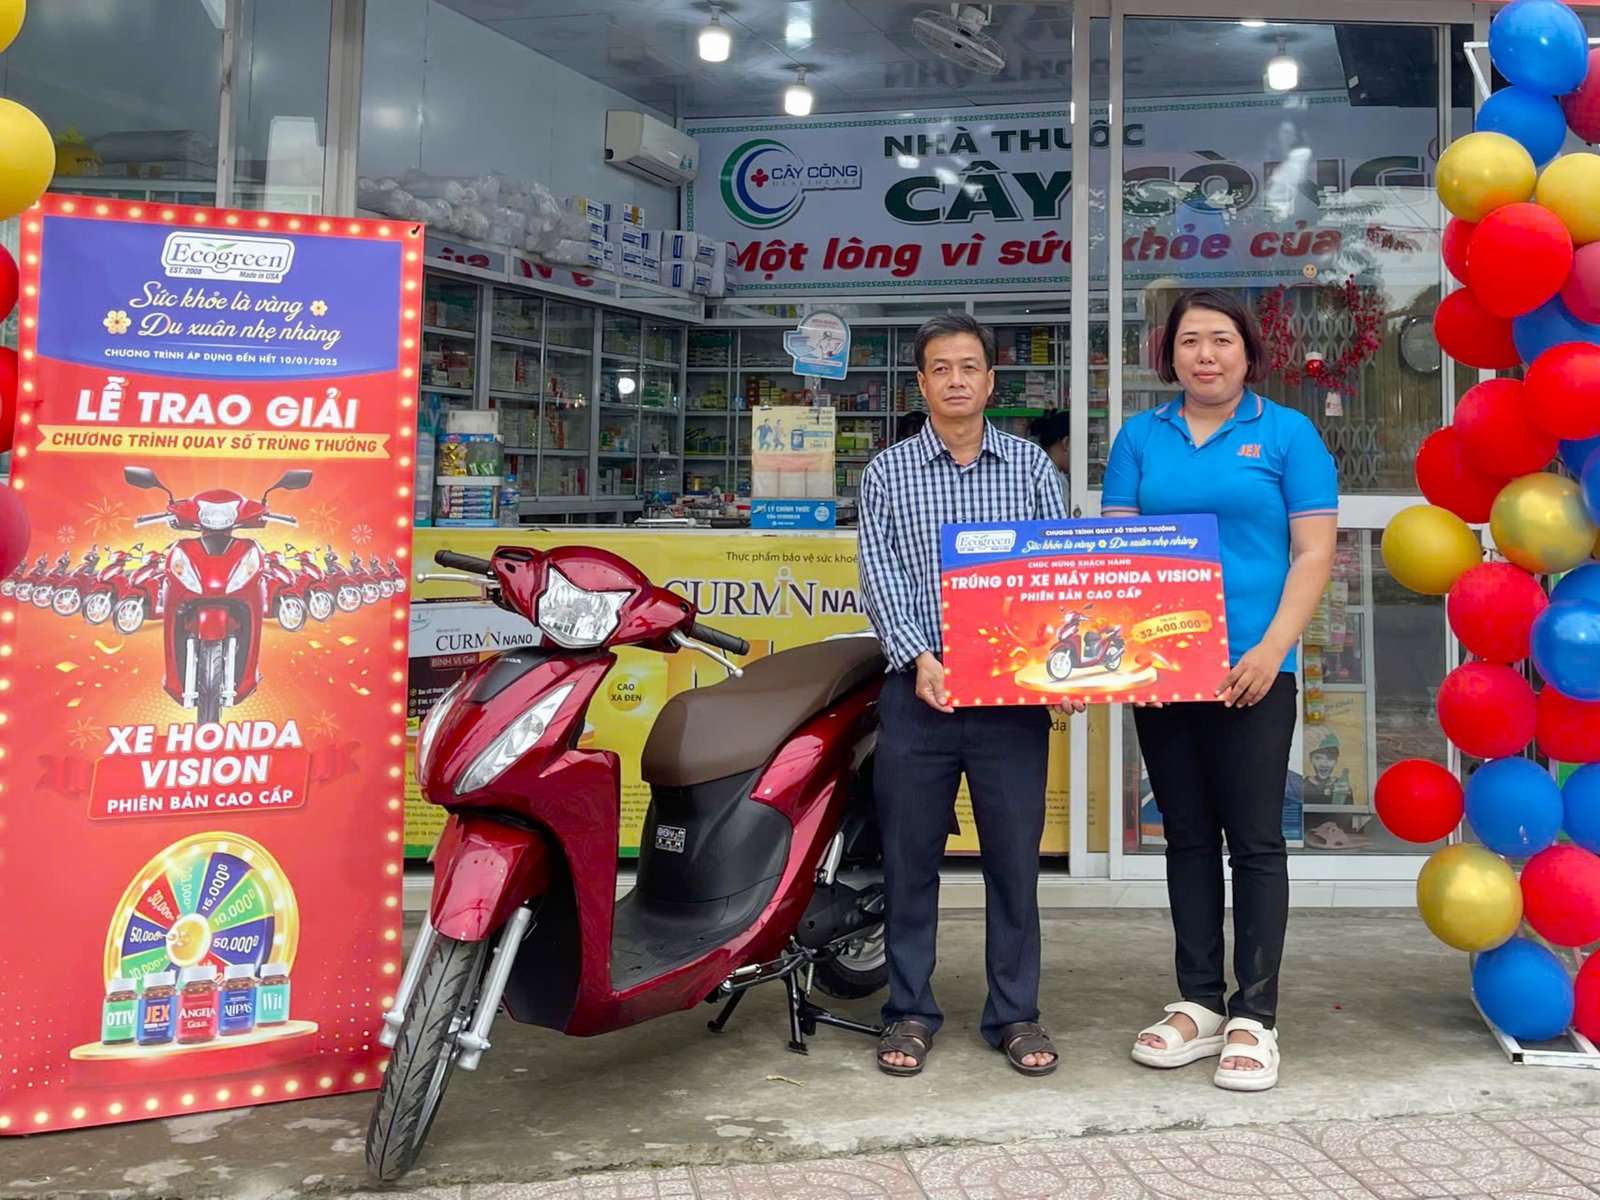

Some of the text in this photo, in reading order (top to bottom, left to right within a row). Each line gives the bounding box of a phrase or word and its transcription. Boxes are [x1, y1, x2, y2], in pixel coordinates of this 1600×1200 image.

[884, 126, 978, 157] NHÀ
[772, 163, 858, 179] CÂY CÒNG
[884, 160, 1072, 223] CÂY
[170, 243, 282, 269] Ecogreen
[727, 239, 809, 280] Một
[822, 237, 922, 277] lòng
[941, 233, 986, 266] vì
[1250, 220, 1342, 258] của
[239, 271, 257, 279] Made
[129, 281, 304, 322] Sức khỏe là vàng
[138, 313, 341, 350] Du xuân nhẹ nhàng
[105, 348, 338, 367] CHƯƠNG TRÌNH ÁP DỤNG ĐẾN HẾT 10/01/2025
[76, 376, 359, 429] LỄ TRAO GIẢI
[52, 431, 378, 453] CHƯƠNG TRÌNH QUAY SỐ TRÚNG THƯỞNG
[1237, 444, 1261, 458] JEX
[960, 535, 1011, 549] Ecogreen
[726, 551, 750, 562] Thực
[752, 551, 780, 565] phẩm
[782, 551, 801, 562] bảo
[802, 552, 814, 564] vệ
[816, 552, 833, 563] sức
[951, 568, 1212, 590] TRÚNG 01 XE MÁY HONDA VISION
[1020, 586, 1142, 602] PHIÊN BẢN CAO CẤP
[436, 627, 533, 651] CURMIN NANO
[1139, 619, 1201, 639] 32.400.000
[431, 656, 452, 668] BÌNH
[463, 656, 475, 665] Gel
[617, 683, 635, 691] CAO
[611, 694, 642, 702] XA ĐEN
[104, 720, 302, 755] XE HONDA
[141, 754, 269, 788] VISION
[107, 785, 294, 813] PHIÊN BẢN CAO CẤP
[145, 1005, 171, 1023] JEX
[179, 1008, 216, 1019] ANGELA
